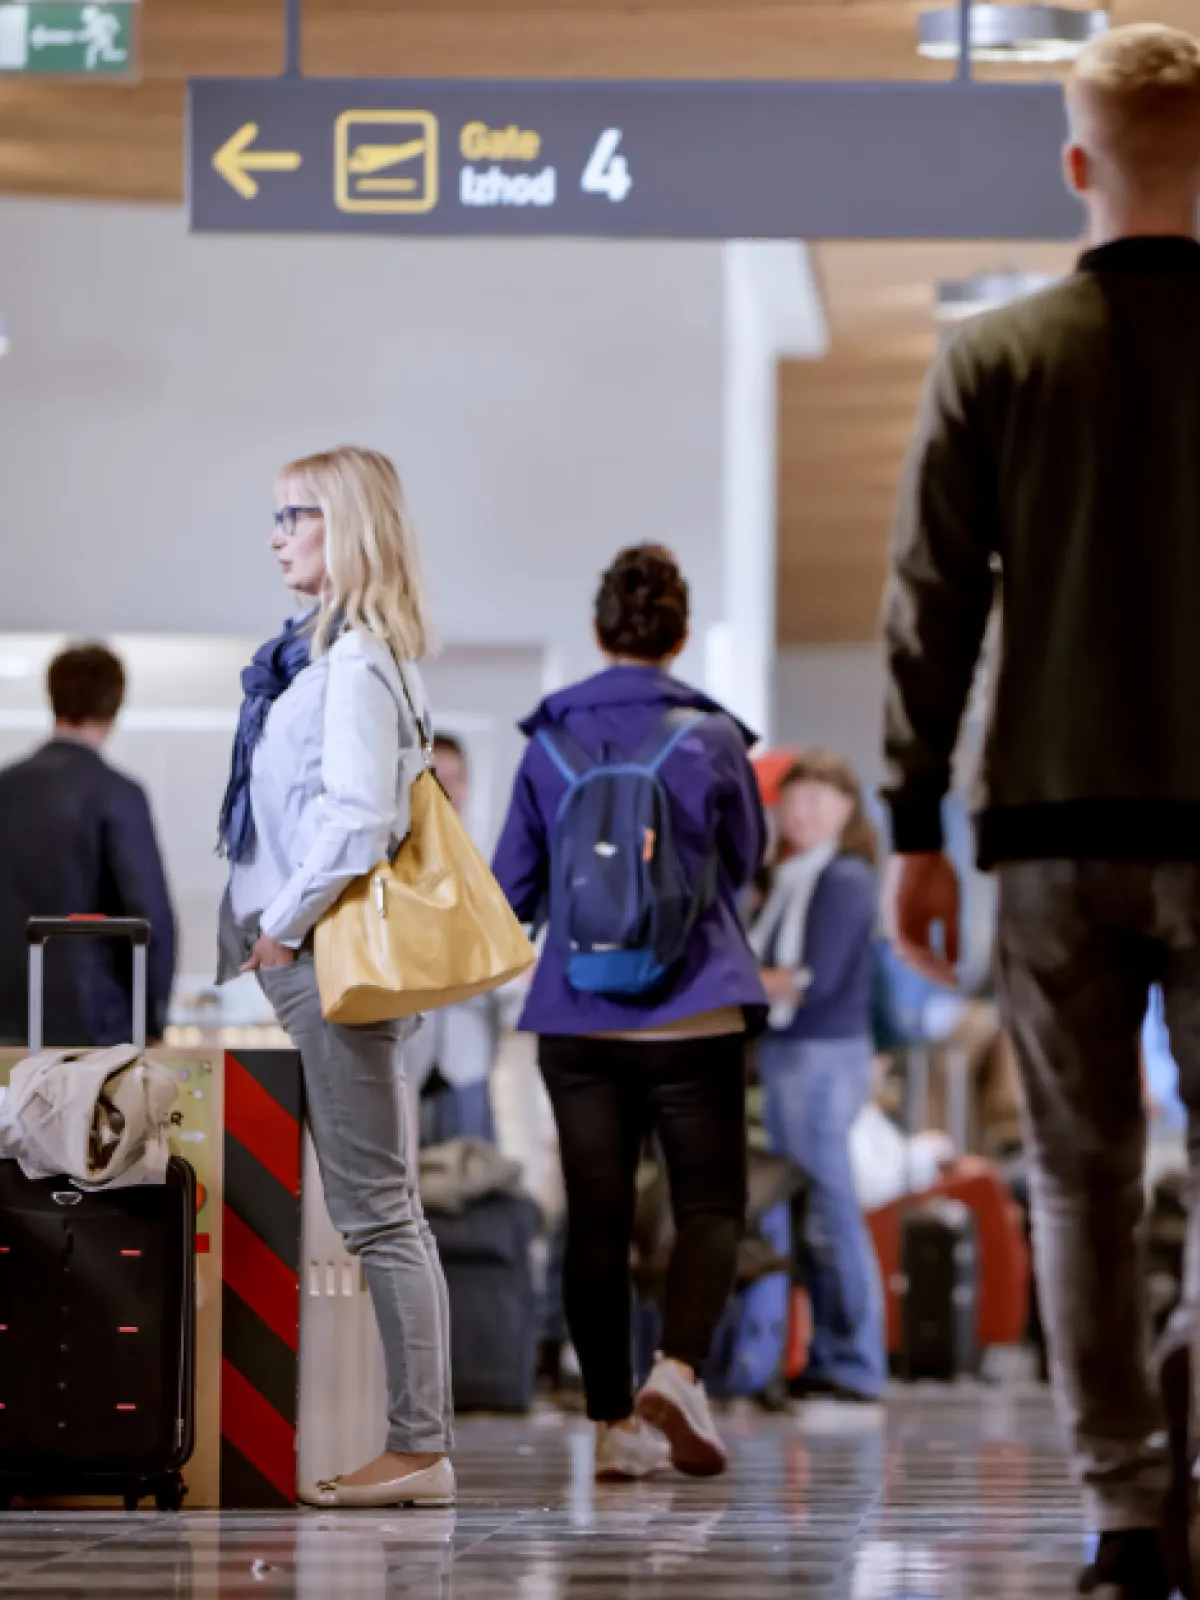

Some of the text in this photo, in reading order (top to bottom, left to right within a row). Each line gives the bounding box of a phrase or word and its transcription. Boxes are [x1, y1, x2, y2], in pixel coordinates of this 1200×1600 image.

[460, 121, 541, 161] Gate
[580, 127, 632, 202] 4
[459, 165, 557, 207] Izhod
